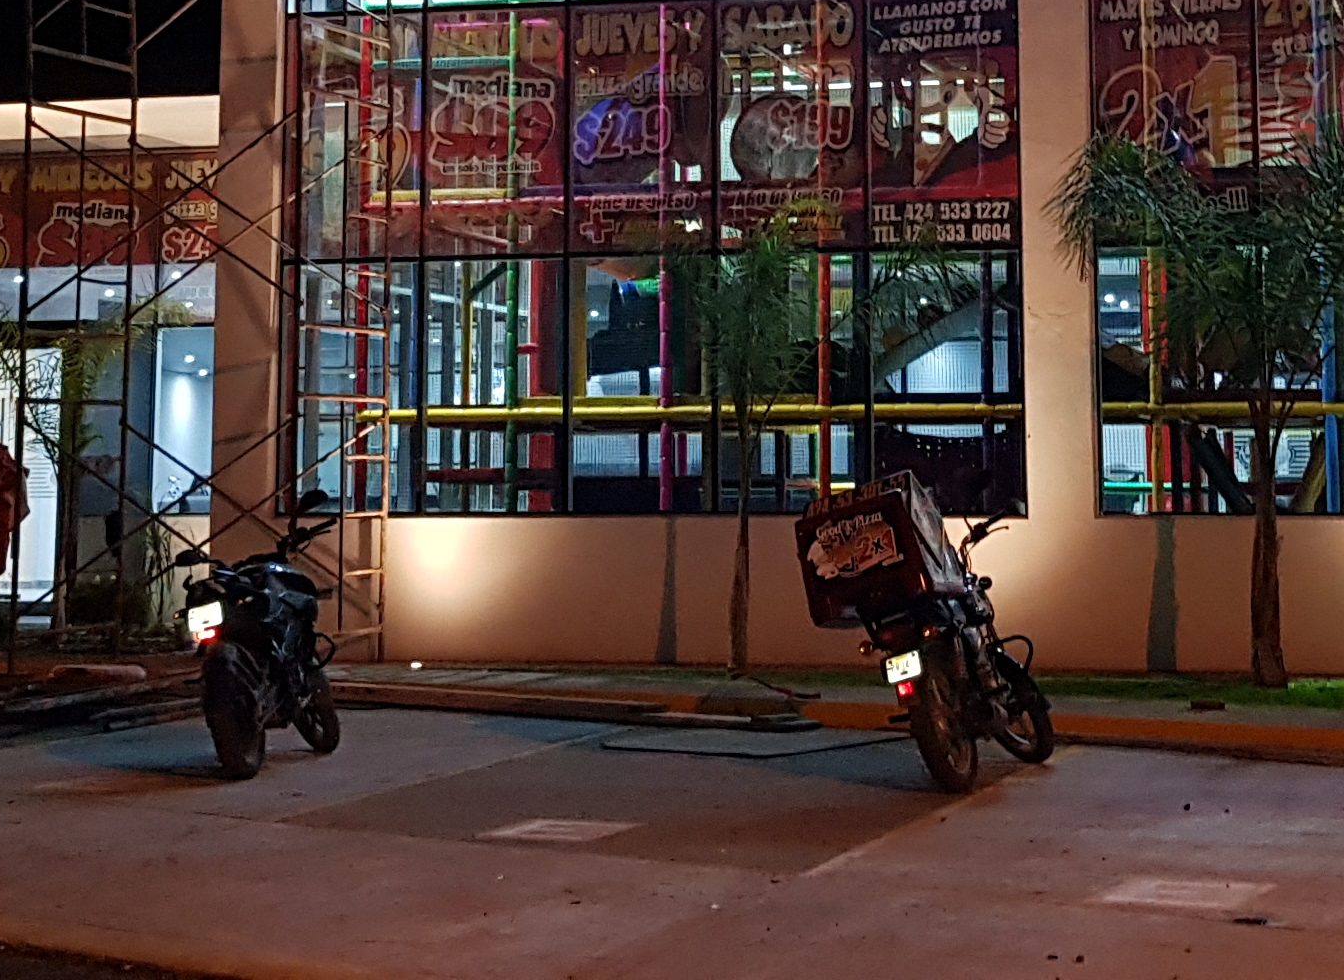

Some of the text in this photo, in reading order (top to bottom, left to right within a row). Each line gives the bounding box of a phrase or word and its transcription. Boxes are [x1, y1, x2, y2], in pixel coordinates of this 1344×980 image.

[874, 0, 967, 20] LLAMANOS
[575, 11, 678, 57] JUEVES
[899, 17, 956, 35] GUSTO
[574, 104, 673, 166] $249
[940, 202, 971, 220] 533
[974, 201, 1010, 220] 1227
[972, 222, 1011, 241] 0604
